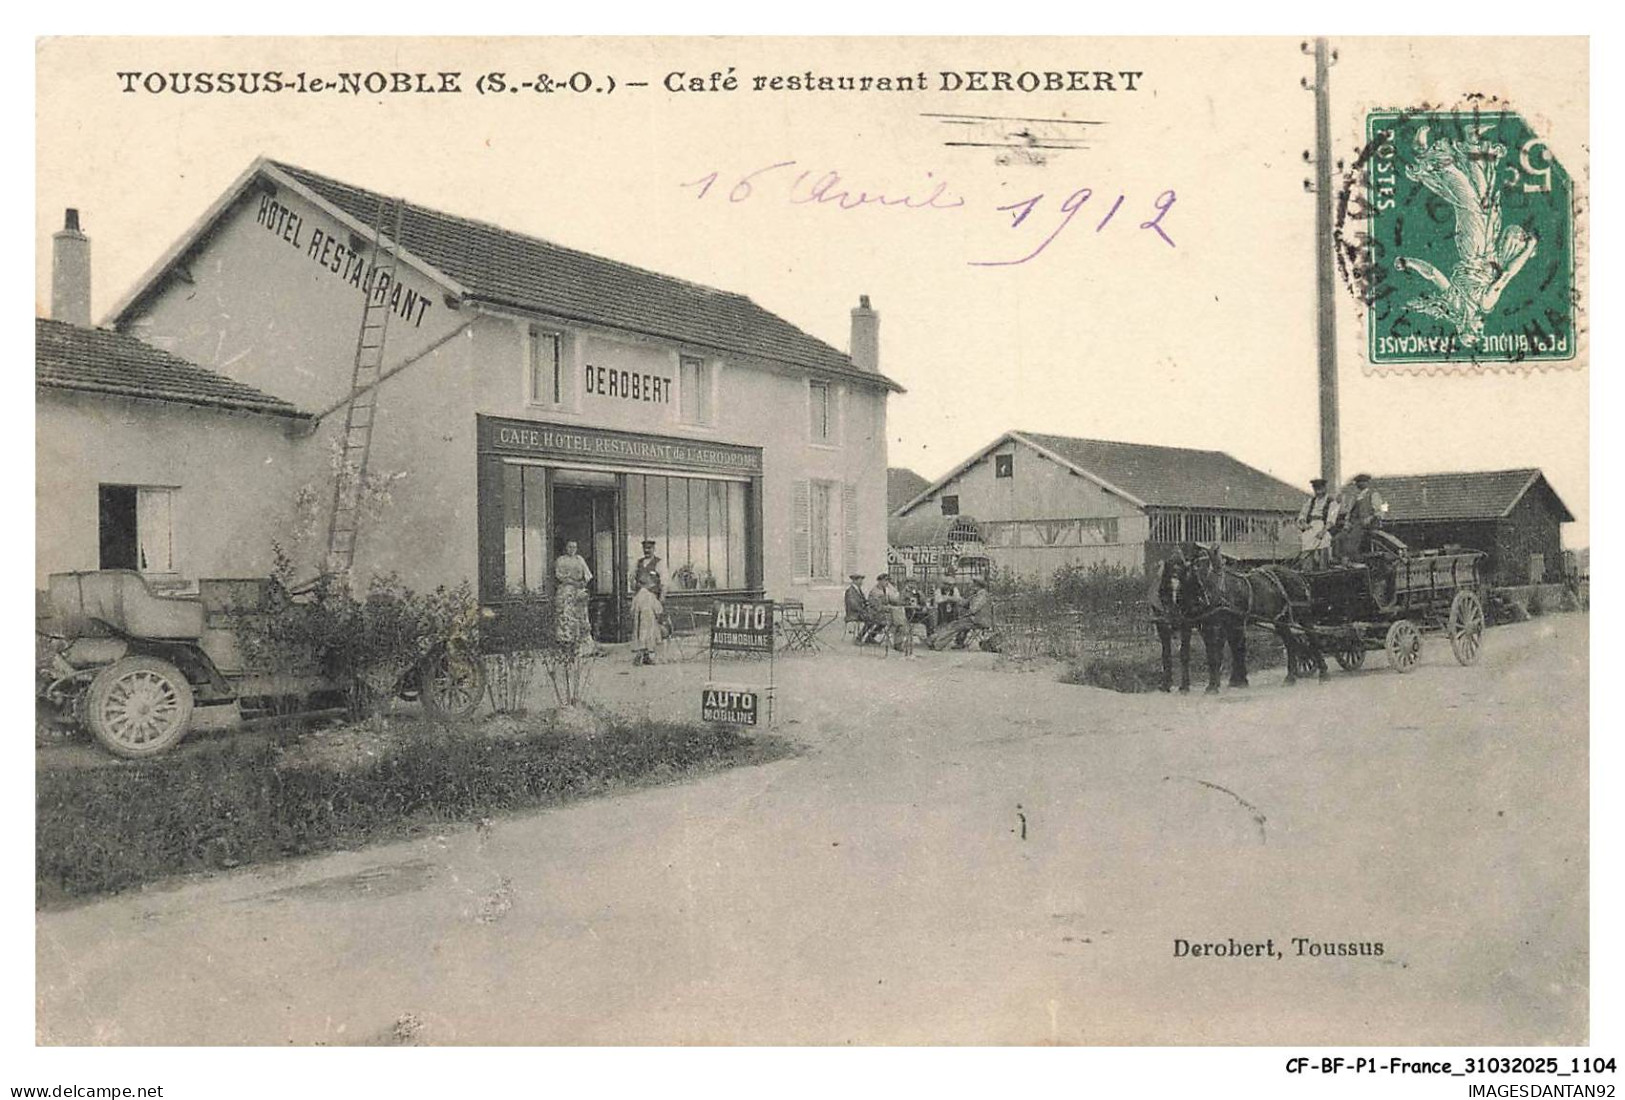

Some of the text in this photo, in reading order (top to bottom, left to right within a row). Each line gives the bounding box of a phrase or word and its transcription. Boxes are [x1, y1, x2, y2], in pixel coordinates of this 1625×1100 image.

[1377, 129, 1395, 210] POSTES
[967, 187, 1178, 267] 1912
[257, 195, 432, 328] HOTEL RESTAURANT
[586, 364, 671, 403] DEROBERT
[544, 432, 591, 451] HOTEL
[595, 439, 672, 459] RESTAURANT
[716, 603, 766, 630] AUTO
[713, 631, 768, 647] AUTOMOBILINE
[706, 690, 752, 710] AUTO
[704, 708, 754, 724] MOBILINE
